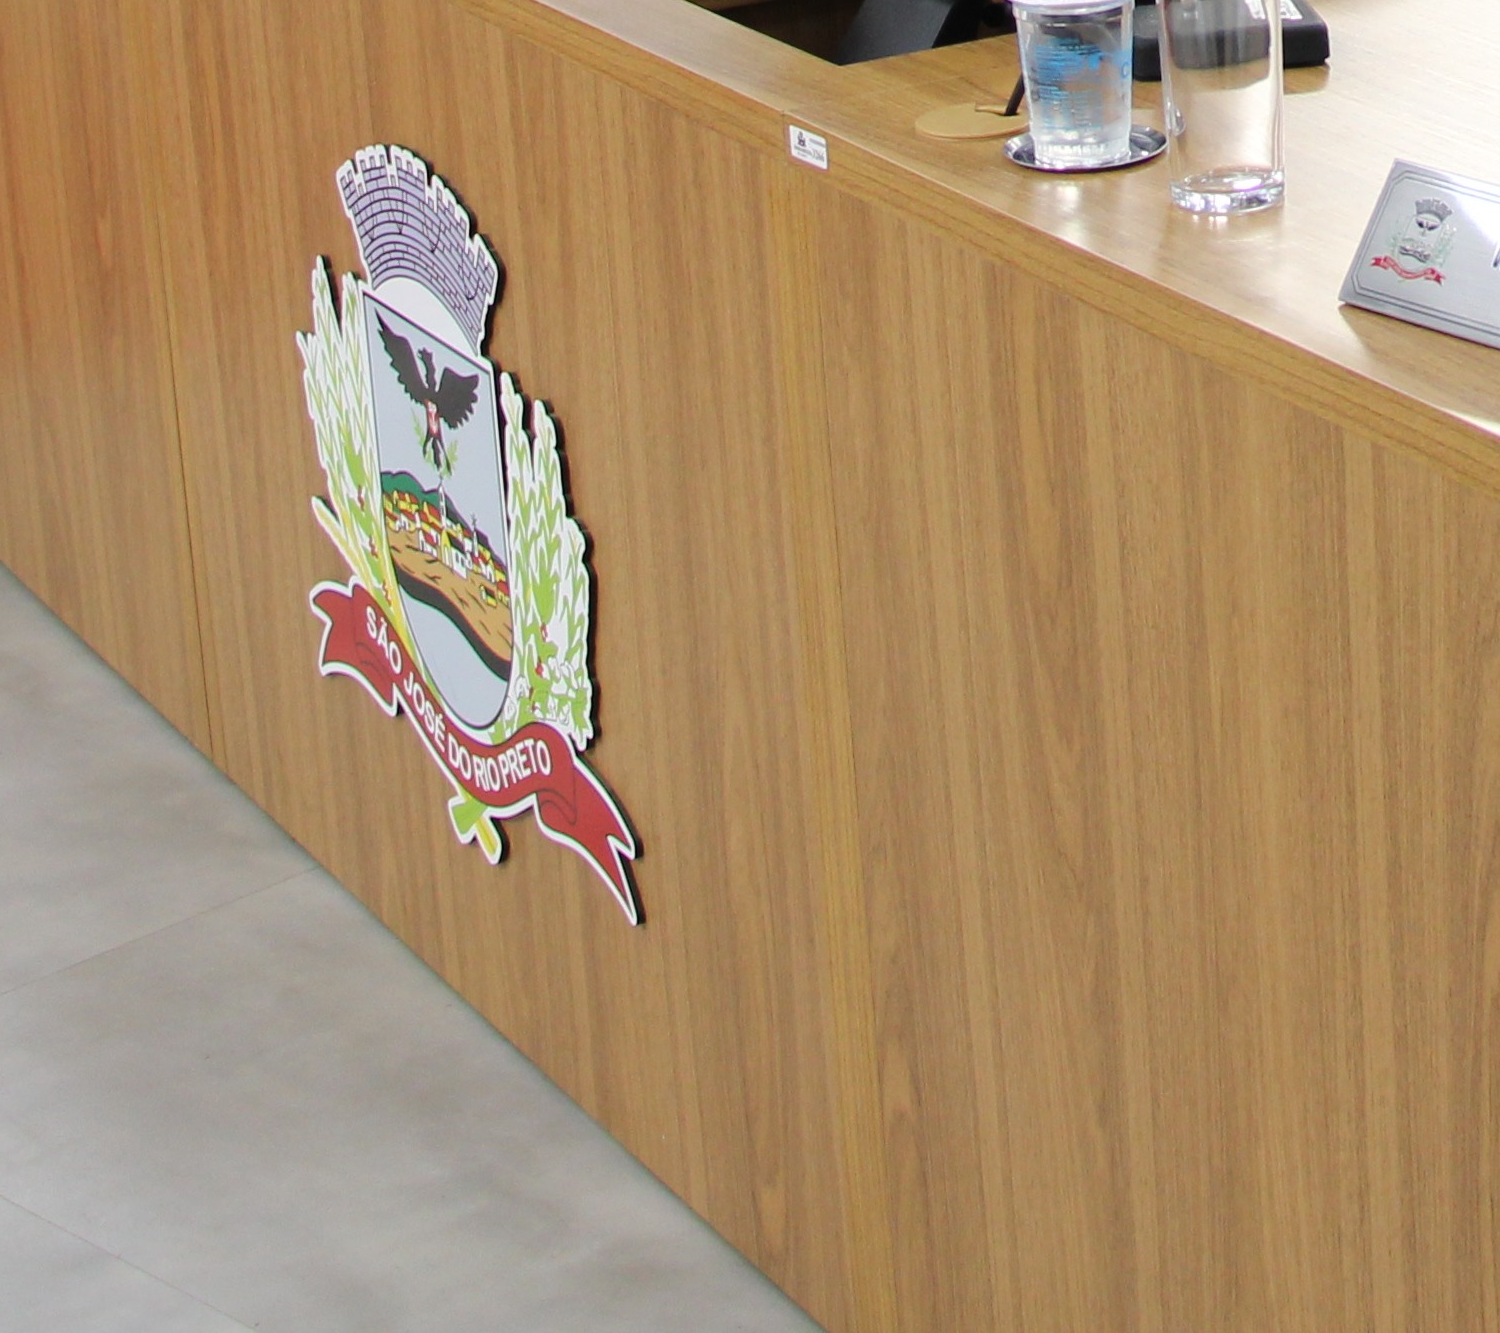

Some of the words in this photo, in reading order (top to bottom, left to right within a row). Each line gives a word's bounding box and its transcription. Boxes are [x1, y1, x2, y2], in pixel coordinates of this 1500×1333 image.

[365, 605, 402, 675] SÃO
[403, 671, 446, 754] JOSÉ
[448, 732, 472, 781] DO
[473, 756, 501, 792] RIO
[499, 737, 551, 789] PRETO
